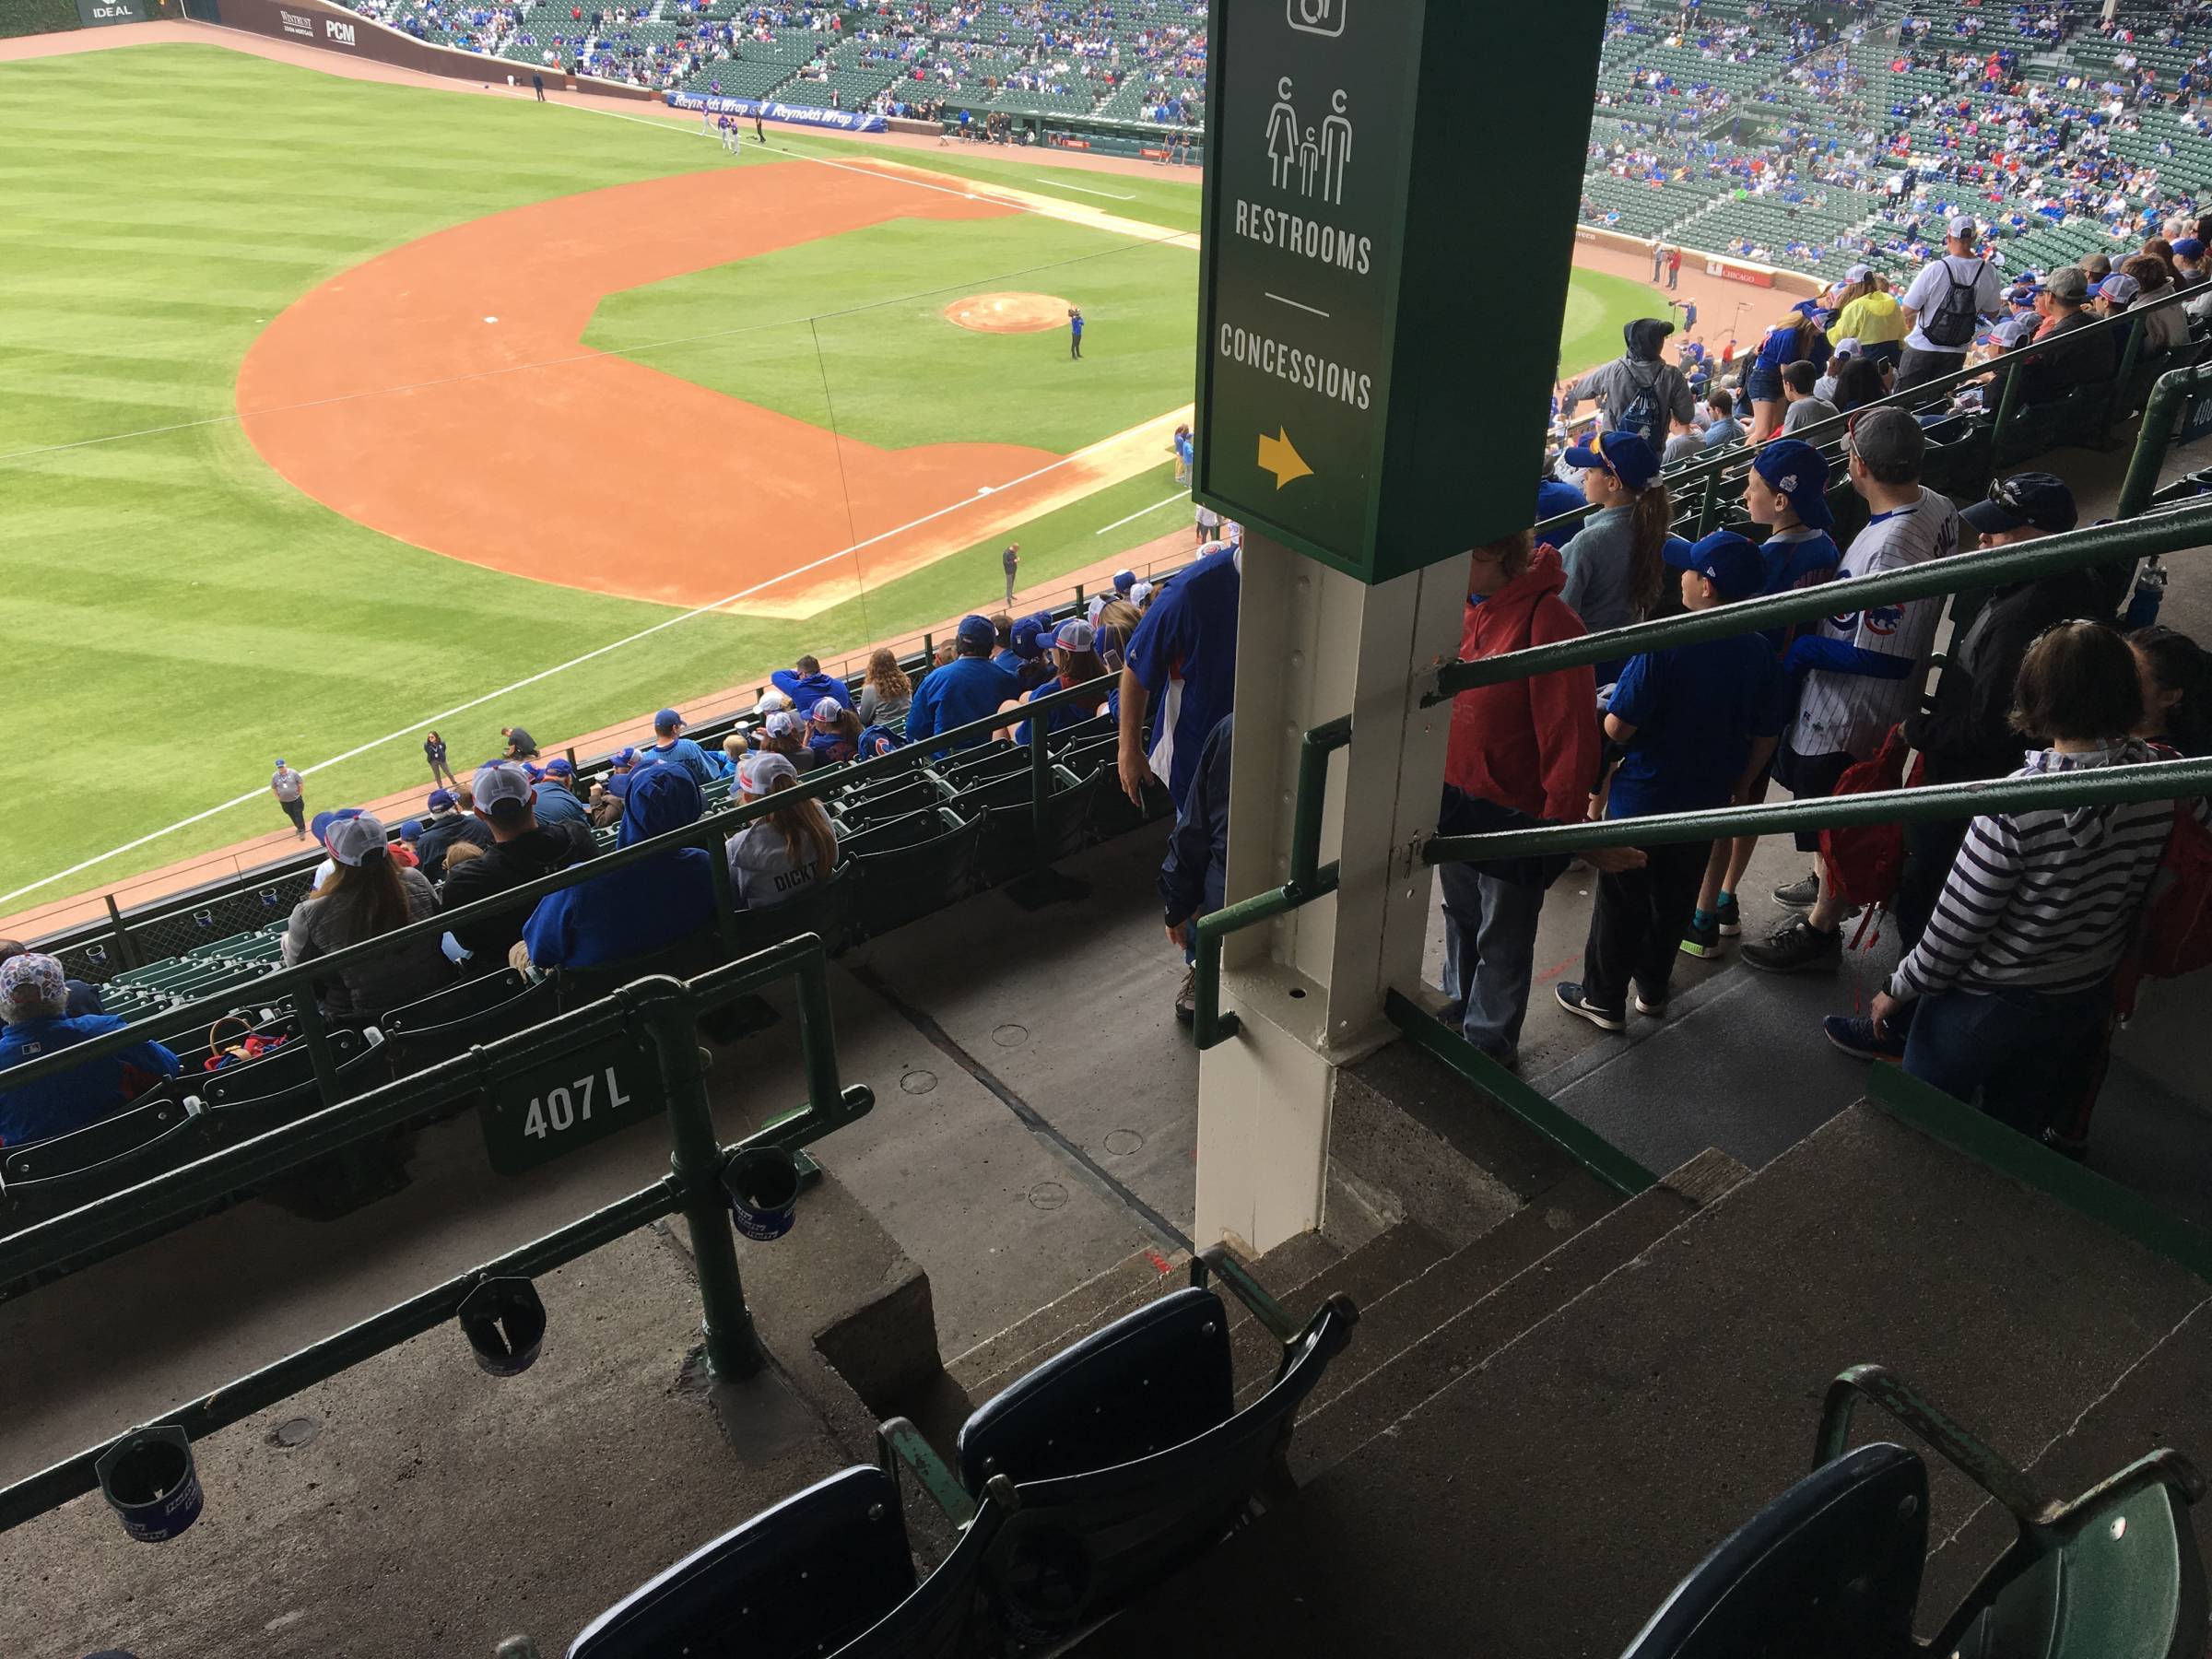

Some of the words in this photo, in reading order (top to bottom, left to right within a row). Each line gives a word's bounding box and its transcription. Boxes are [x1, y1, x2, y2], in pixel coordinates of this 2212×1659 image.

[93, 6, 133, 18] IDEAL
[326, 19, 355, 42] PCM
[674, 95, 720, 110] Reynlds
[721, 99, 748, 116] Wrap
[771, 103, 822, 121] Reynolds
[821, 110, 853, 127] Wrap
[1235, 199, 1371, 275] RESTROOMS
[1723, 270, 1755, 283] CHICAGO
[1220, 323, 1371, 410] CONCESSIONS
[524, 1075, 594, 1139] 407
[605, 1066, 630, 1108] L
